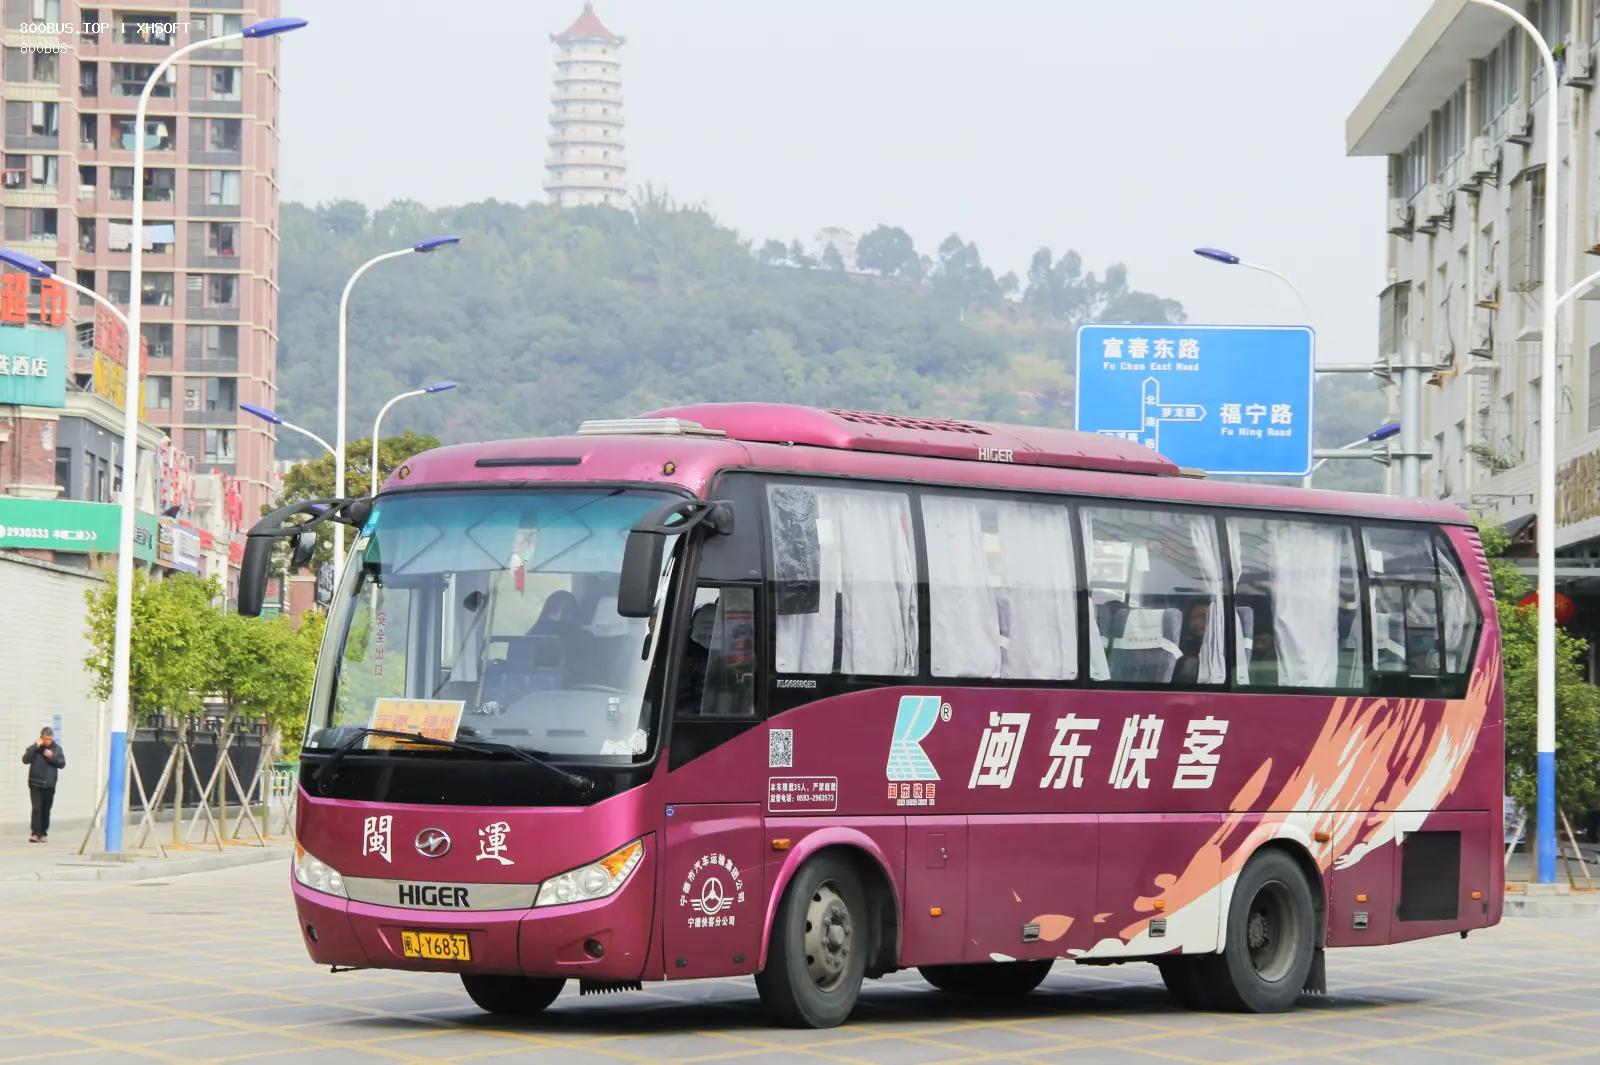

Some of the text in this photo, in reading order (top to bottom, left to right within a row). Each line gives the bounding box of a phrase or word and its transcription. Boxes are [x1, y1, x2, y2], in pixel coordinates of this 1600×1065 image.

[1, 271, 68, 325] 超市
[1102, 337, 1200, 359] 富春东路
[1103, 361, 1200, 371] Fu Chun East Road
[1219, 403, 1293, 425] 福宁路
[1221, 427, 1292, 439] Fu Ning Road
[978, 447, 1014, 463] HIGER
[375, 612, 387, 677] 安全出口
[967, 711, 1230, 790] 闽东快客
[887, 782, 936, 799] 闽东快客
[399, 884, 471, 908] HIGER
[687, 915, 736, 929] 宁德快客分公司
